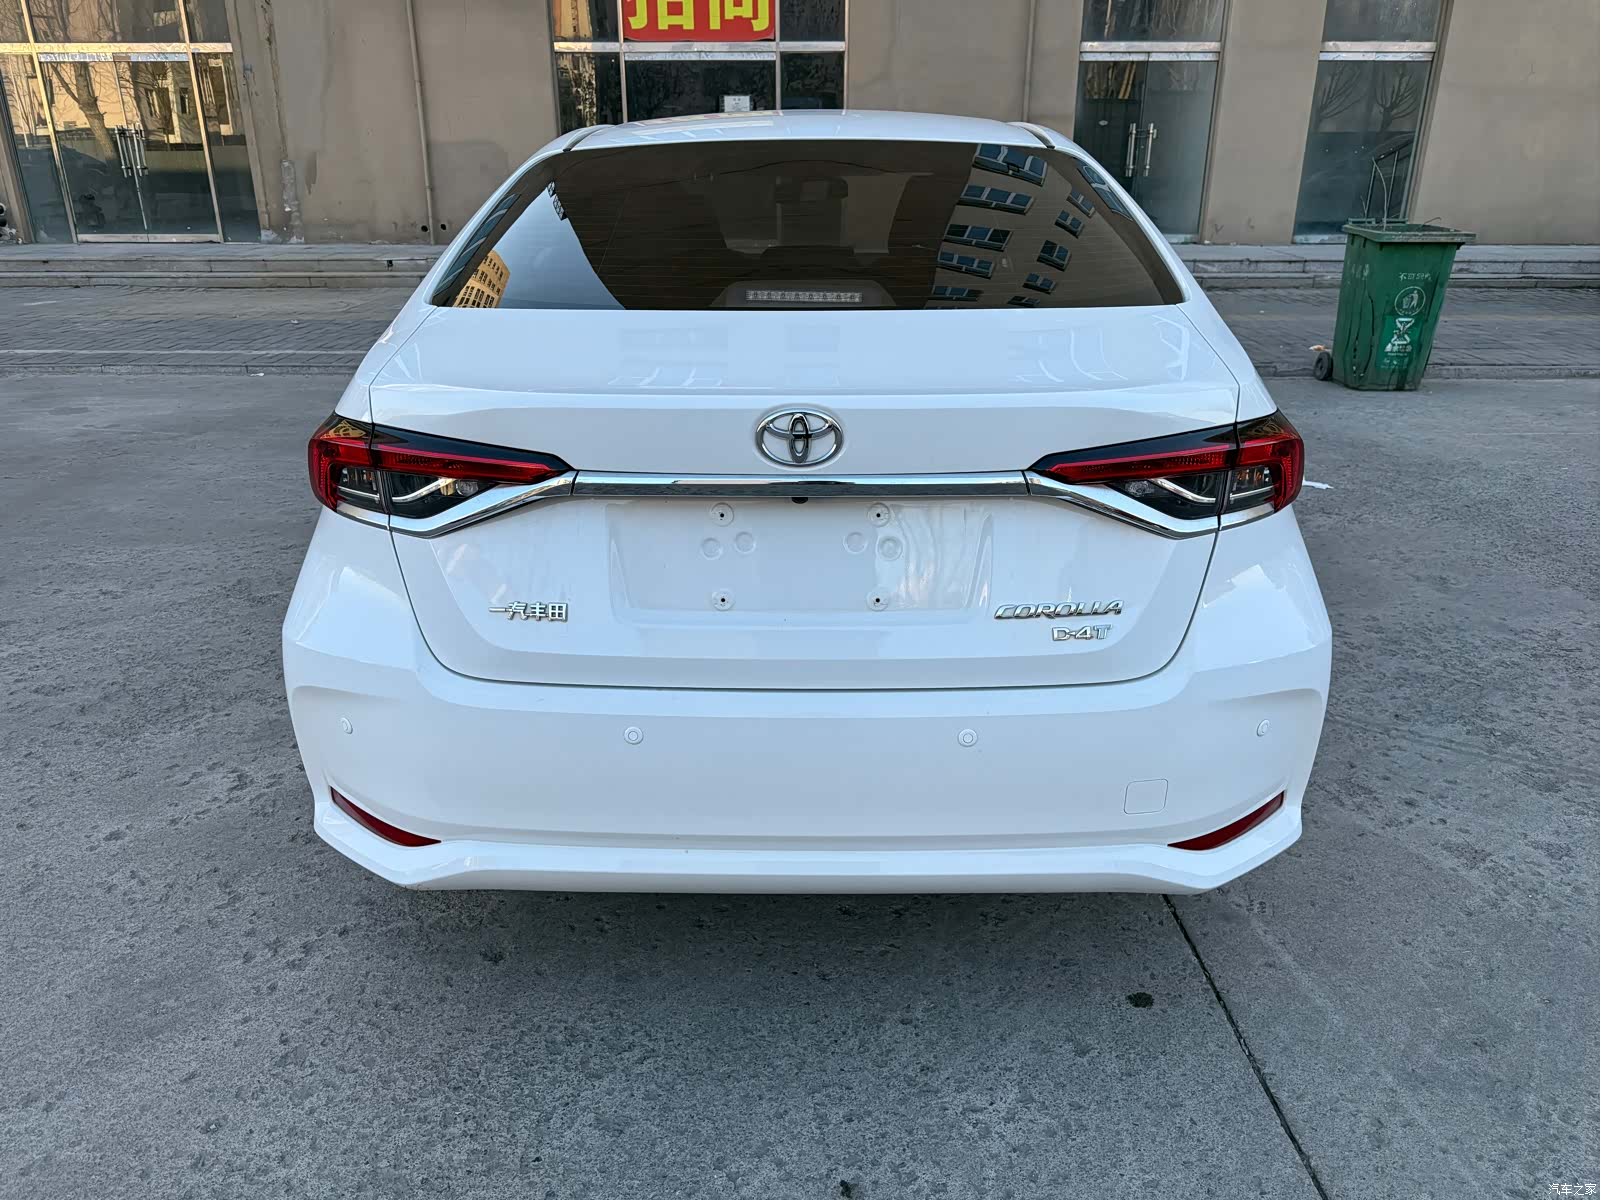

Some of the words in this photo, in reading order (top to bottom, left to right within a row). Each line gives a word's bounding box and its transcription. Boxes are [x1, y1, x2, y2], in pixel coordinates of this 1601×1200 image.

[488, 601, 568, 622] 一汽丰田
[994, 600, 1124, 619] COROLLA
[1052, 624, 1112, 641] D-4T
